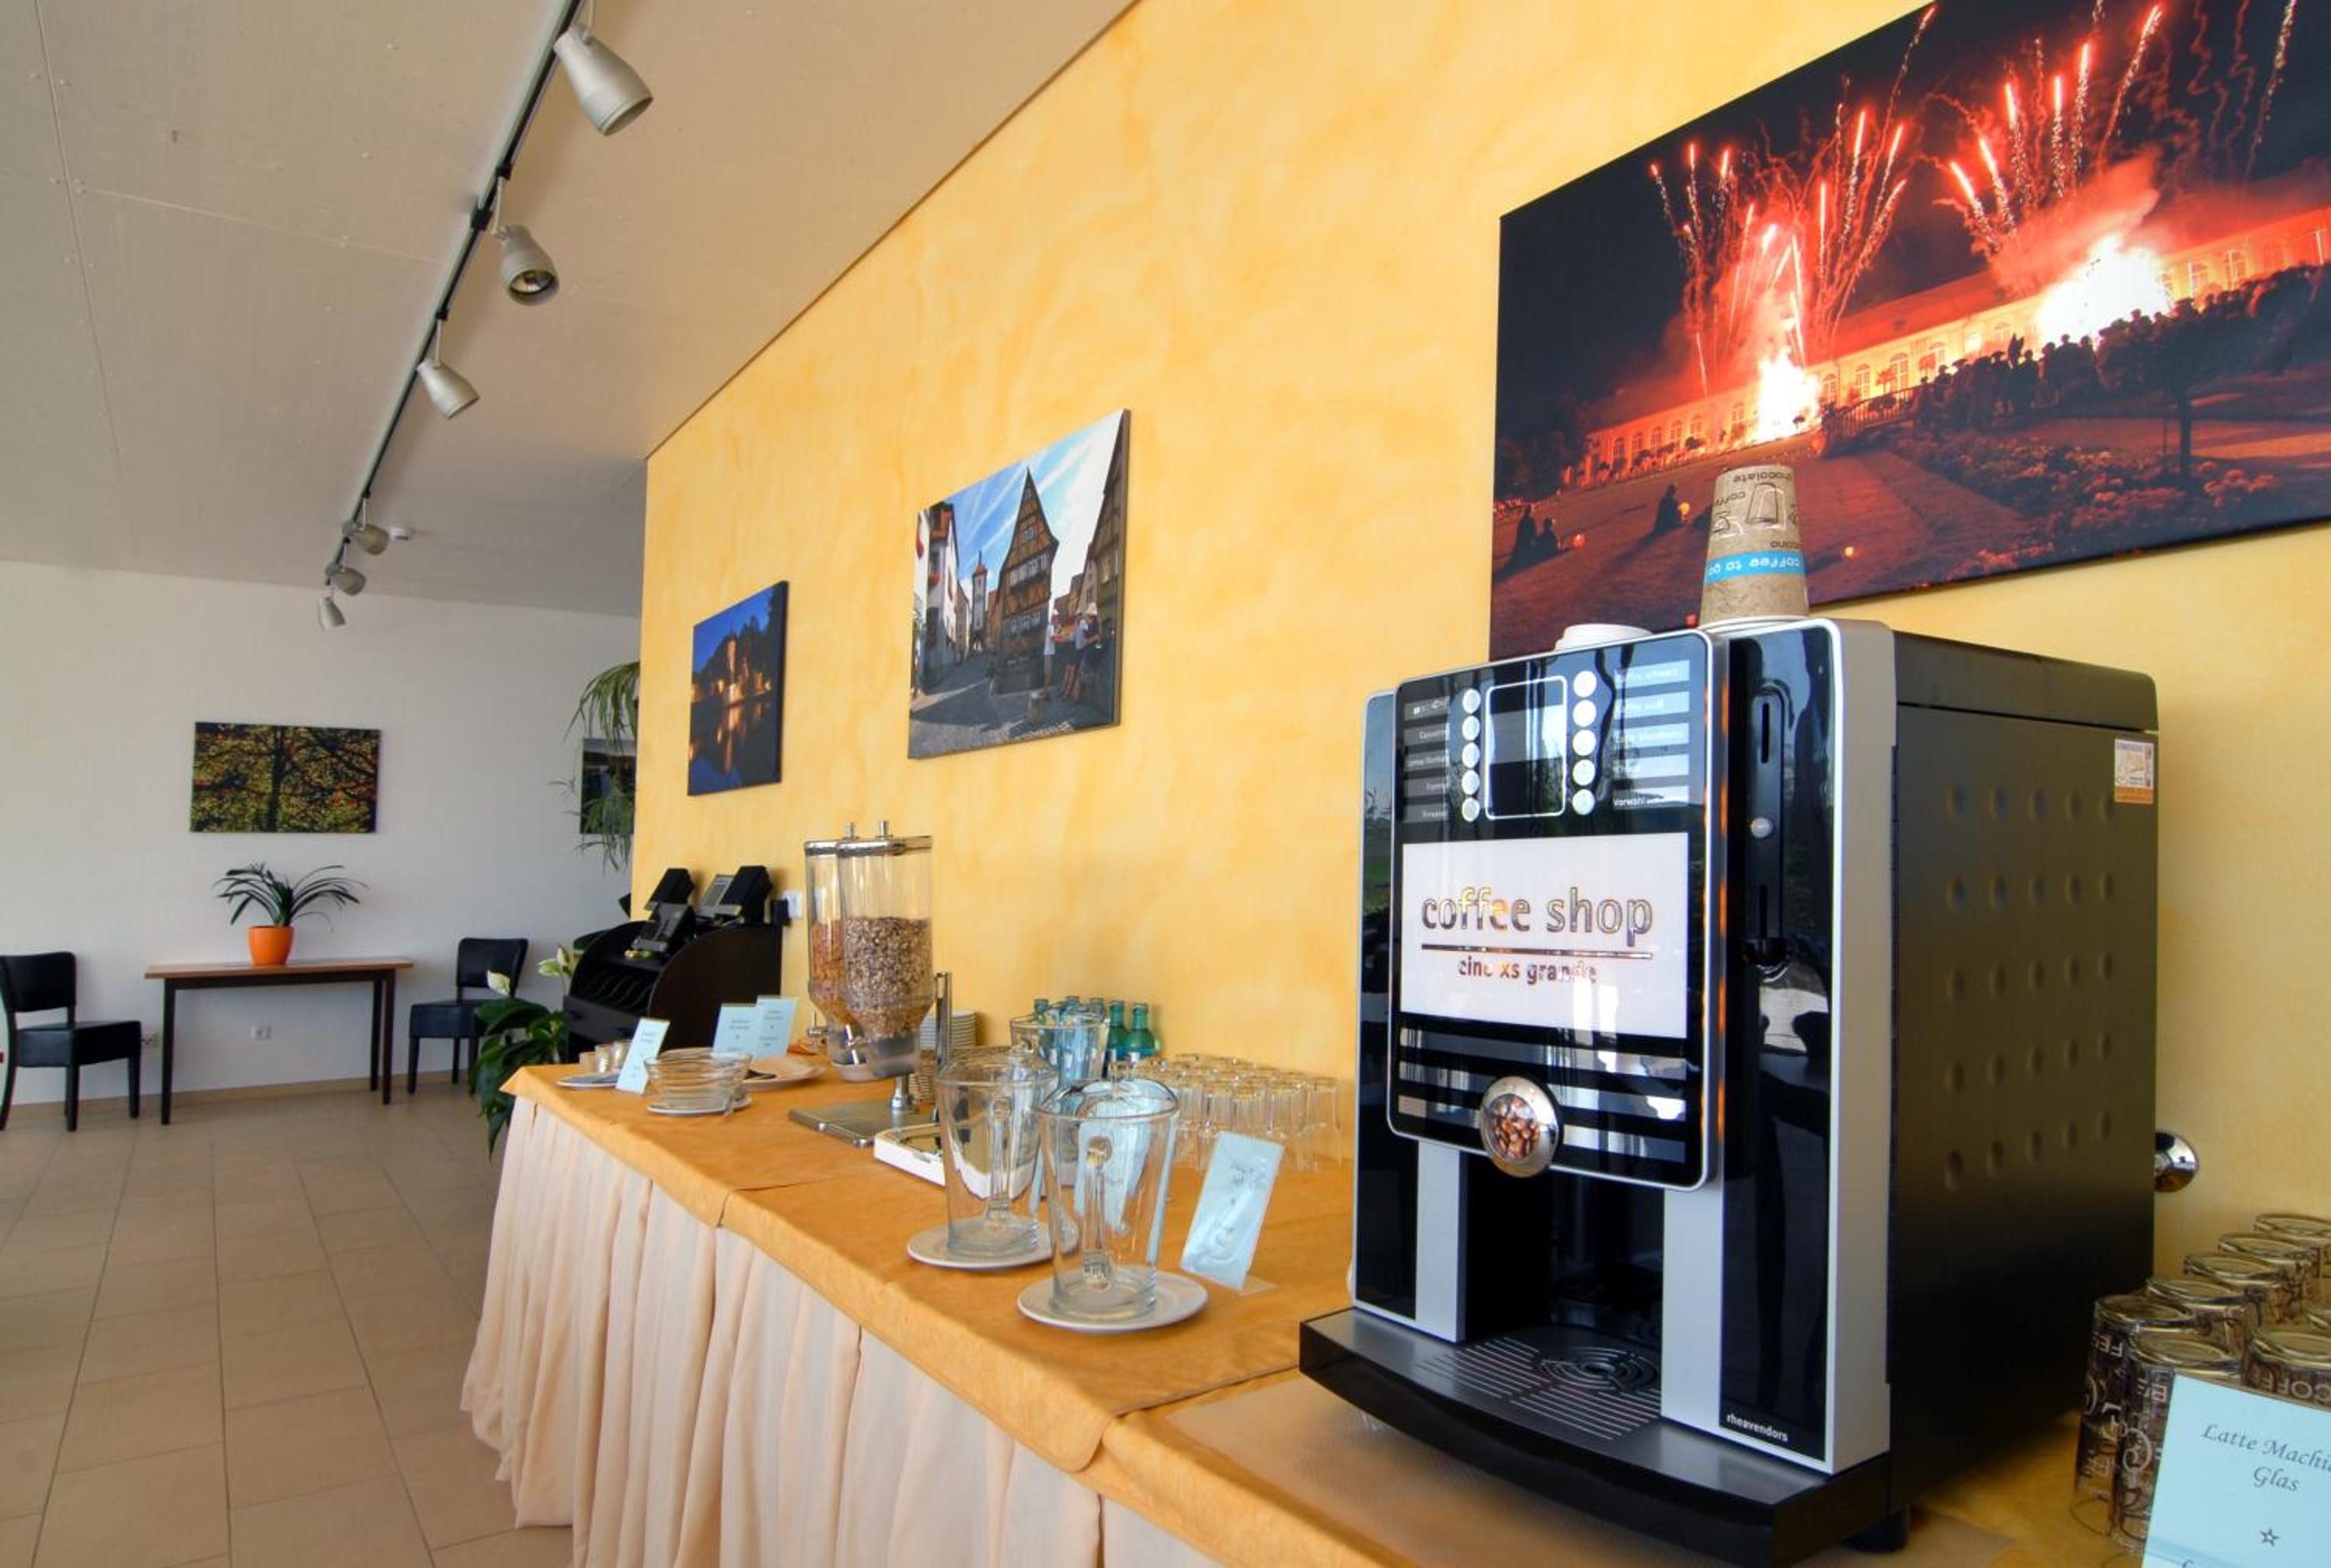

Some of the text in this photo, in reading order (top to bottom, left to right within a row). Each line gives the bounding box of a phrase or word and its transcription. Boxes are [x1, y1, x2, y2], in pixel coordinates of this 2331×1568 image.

[1420, 886, 1654, 946] coffee shop
[1527, 960, 1597, 985] grande
[1726, 1413, 1789, 1442] rheavendors
[2201, 1423, 2258, 1451] Latte
[2252, 1465, 2301, 1492] Glas
